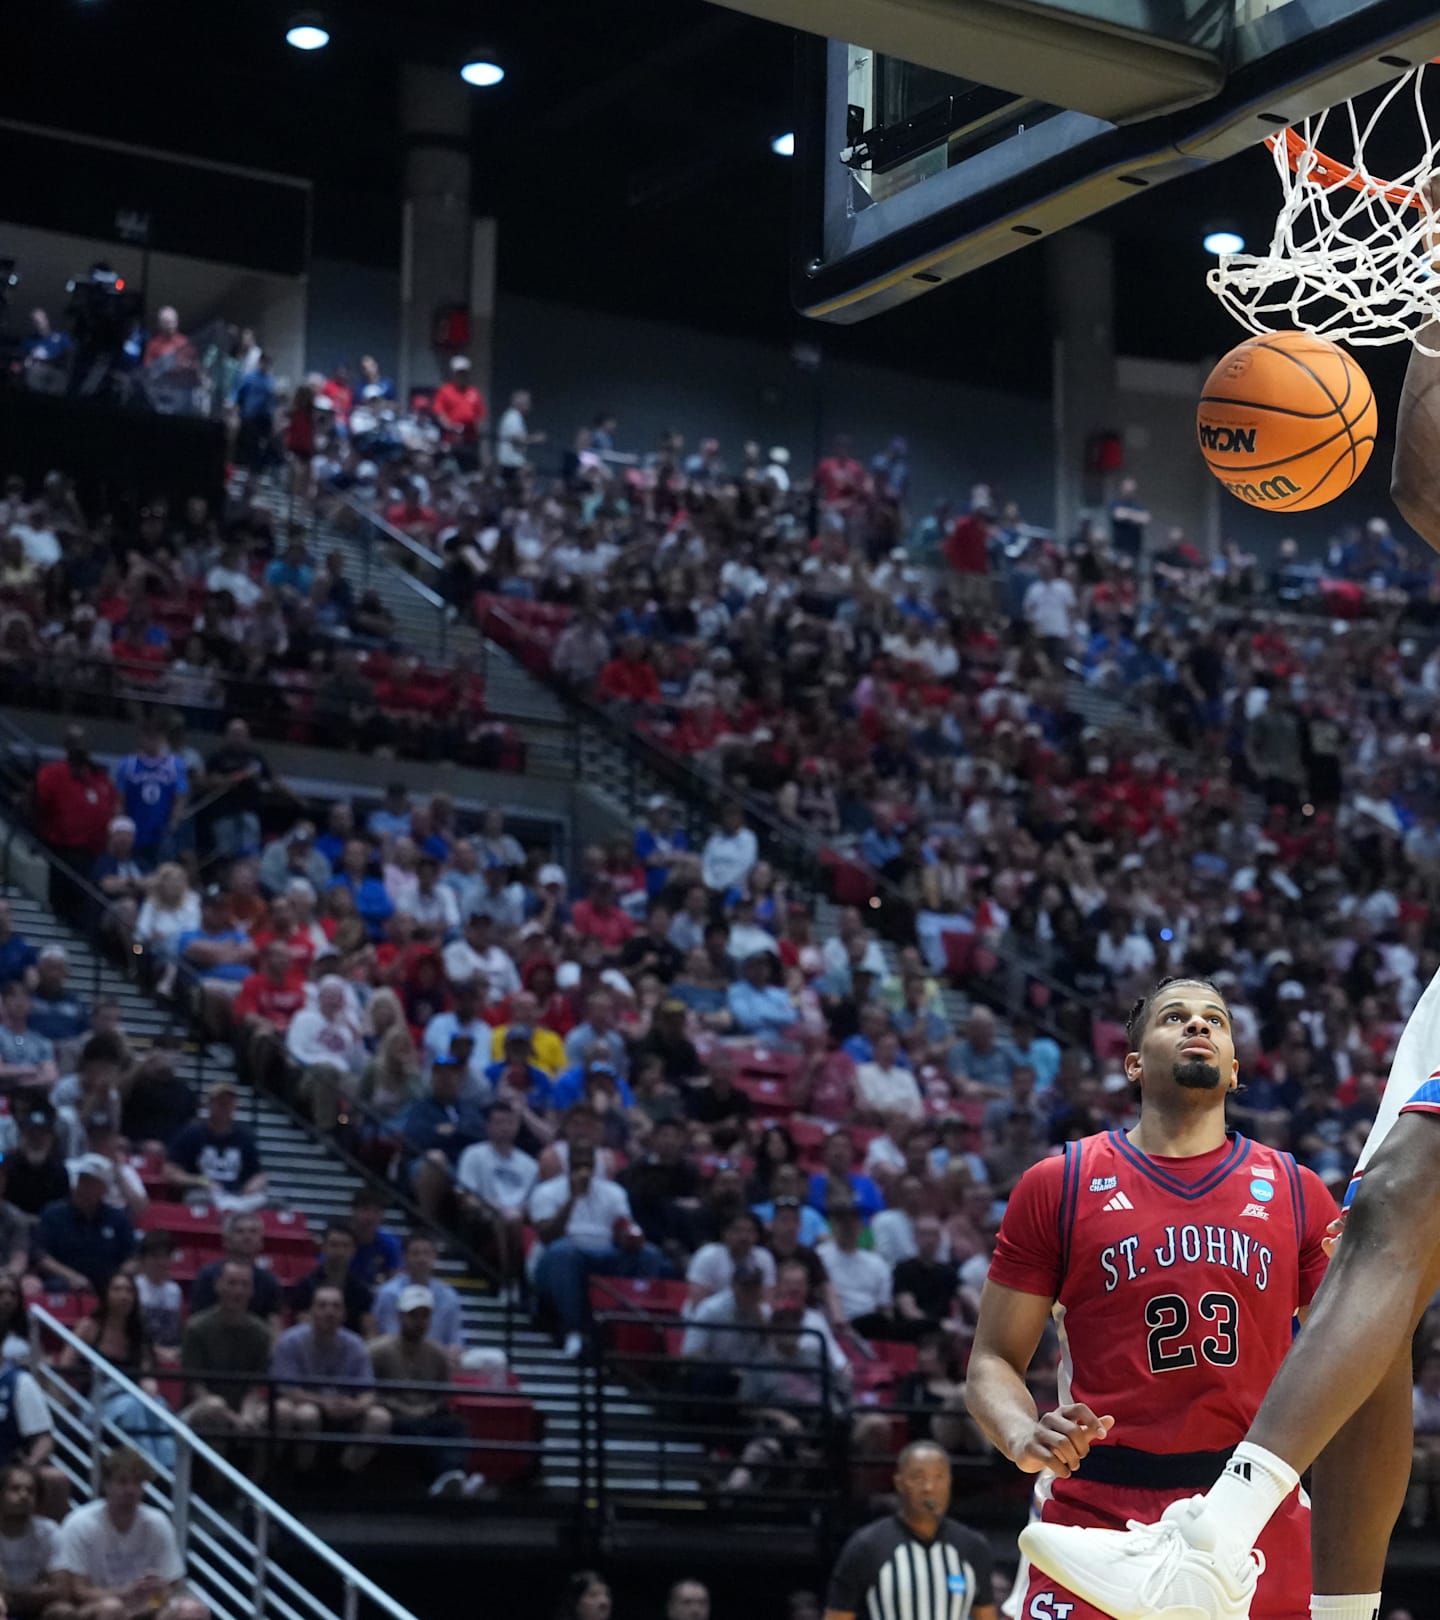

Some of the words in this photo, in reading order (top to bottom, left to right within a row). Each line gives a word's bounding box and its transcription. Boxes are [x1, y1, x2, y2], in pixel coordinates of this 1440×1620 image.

[1200, 423, 1257, 453] NCAA
[1101, 1234, 1147, 1292] ST.
[1155, 1225, 1272, 1291] JOHN'S
[1145, 1292, 1239, 1373] 23
